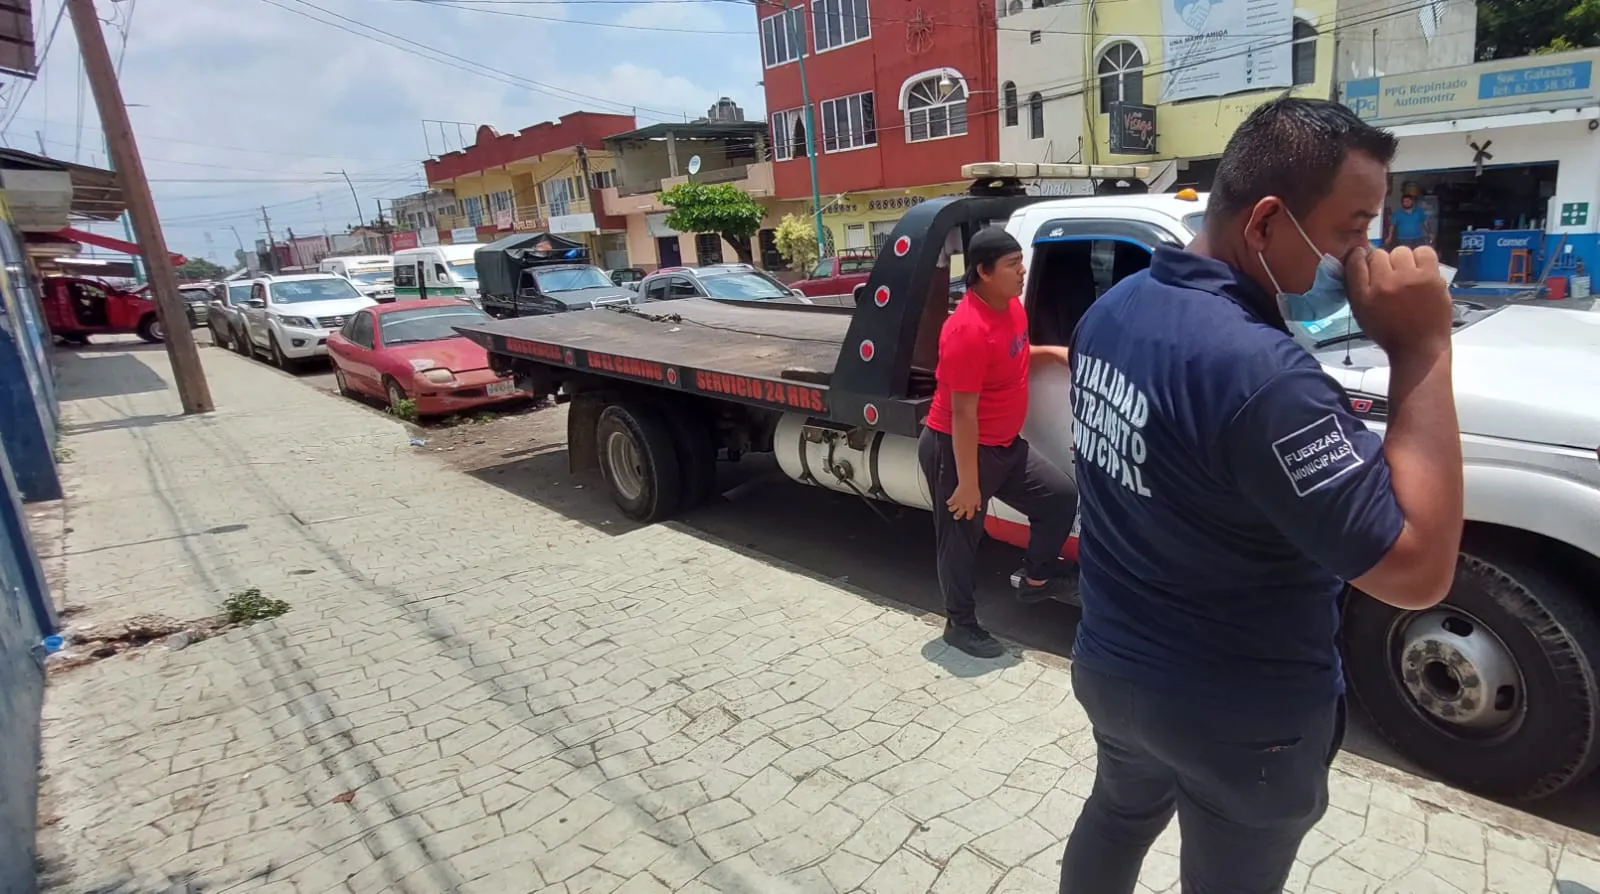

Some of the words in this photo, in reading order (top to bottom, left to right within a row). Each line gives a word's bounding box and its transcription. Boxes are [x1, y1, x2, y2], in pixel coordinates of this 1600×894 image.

[1206, 29, 1228, 39] AMIGA
[1385, 86, 1406, 96] PPG
[1410, 78, 1468, 94] Repintado
[1394, 93, 1456, 108] Automotriz
[696, 370, 763, 399] SERVICIO
[765, 381, 785, 404] 24
[787, 385, 828, 412] HRS.
[1075, 352, 1149, 428] VIALIDAD
[1073, 384, 1081, 414] Y
[1080, 389, 1147, 465] TRANSITO
[1284, 431, 1341, 466] FUERZAS
[1291, 444, 1351, 482] MUNICIPALES
